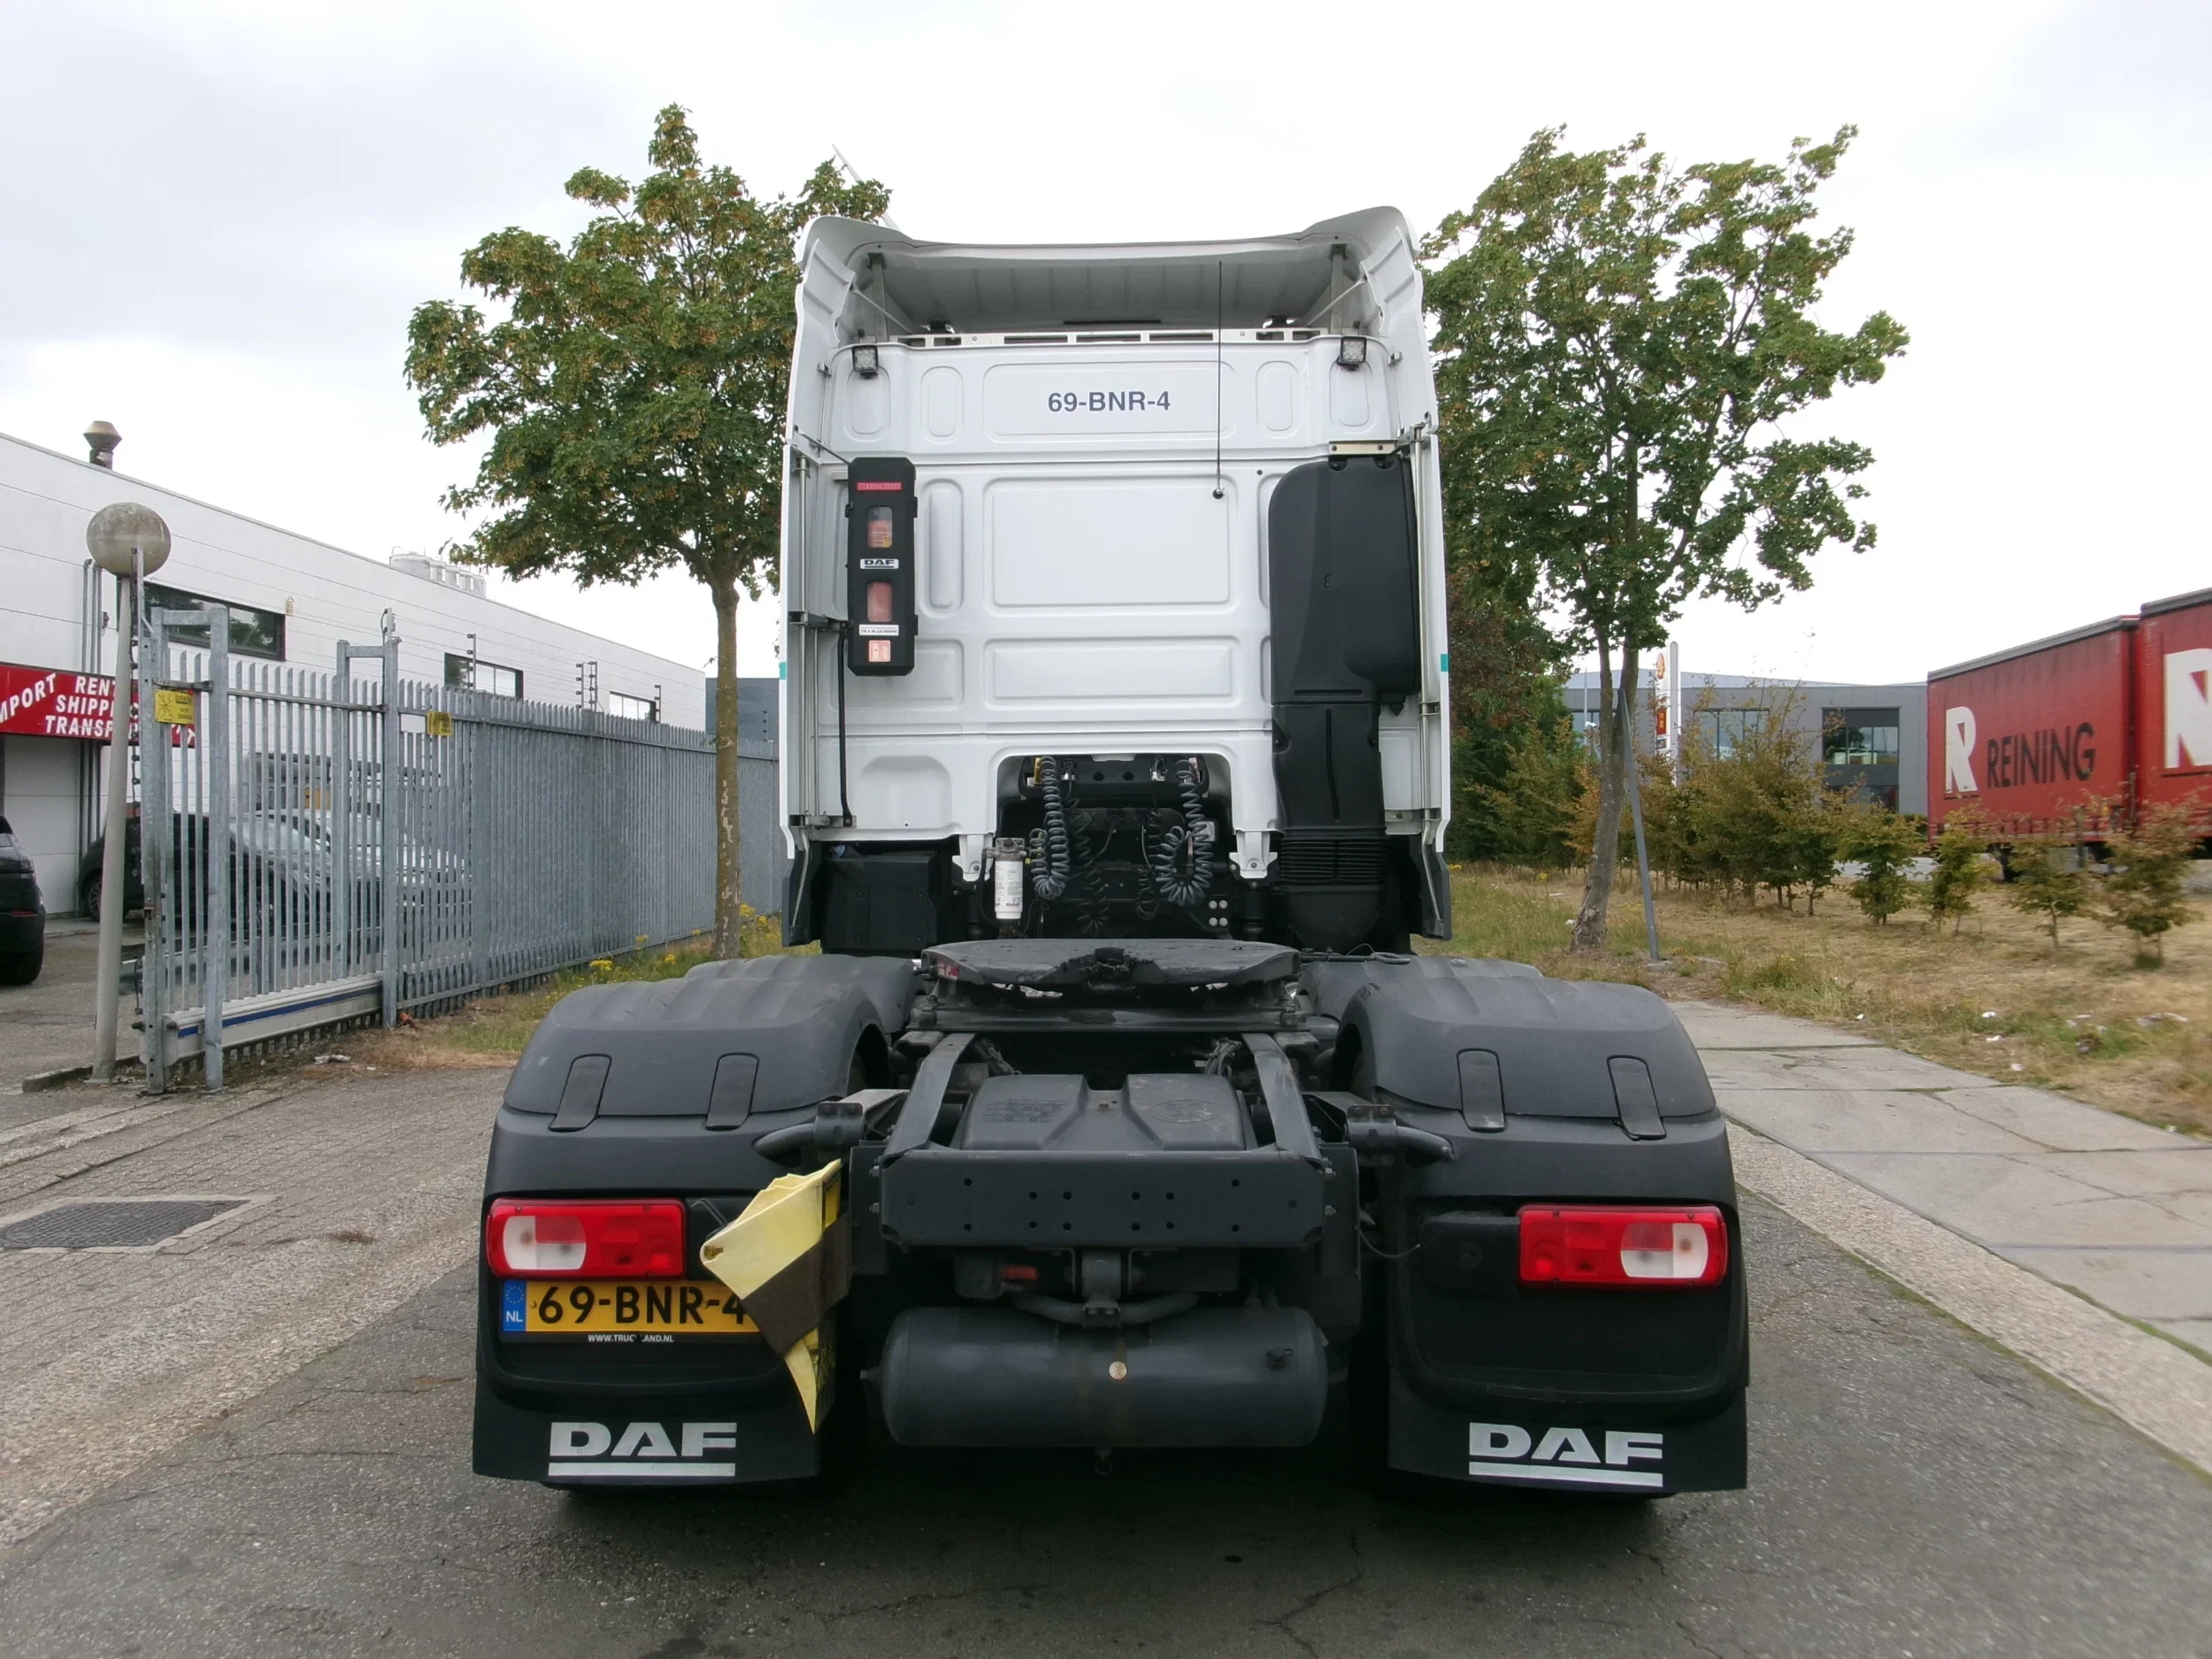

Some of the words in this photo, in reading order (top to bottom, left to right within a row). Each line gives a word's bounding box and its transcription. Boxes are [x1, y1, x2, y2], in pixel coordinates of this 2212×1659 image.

[1048, 390, 1171, 413] 69-BNR-4
[1986, 720, 2097, 790] REINING
[505, 1310, 524, 1323] NL
[537, 1286, 748, 1325] 69-BNR-4
[549, 1421, 738, 1457] DAF
[1468, 1422, 1664, 1466] DAF
